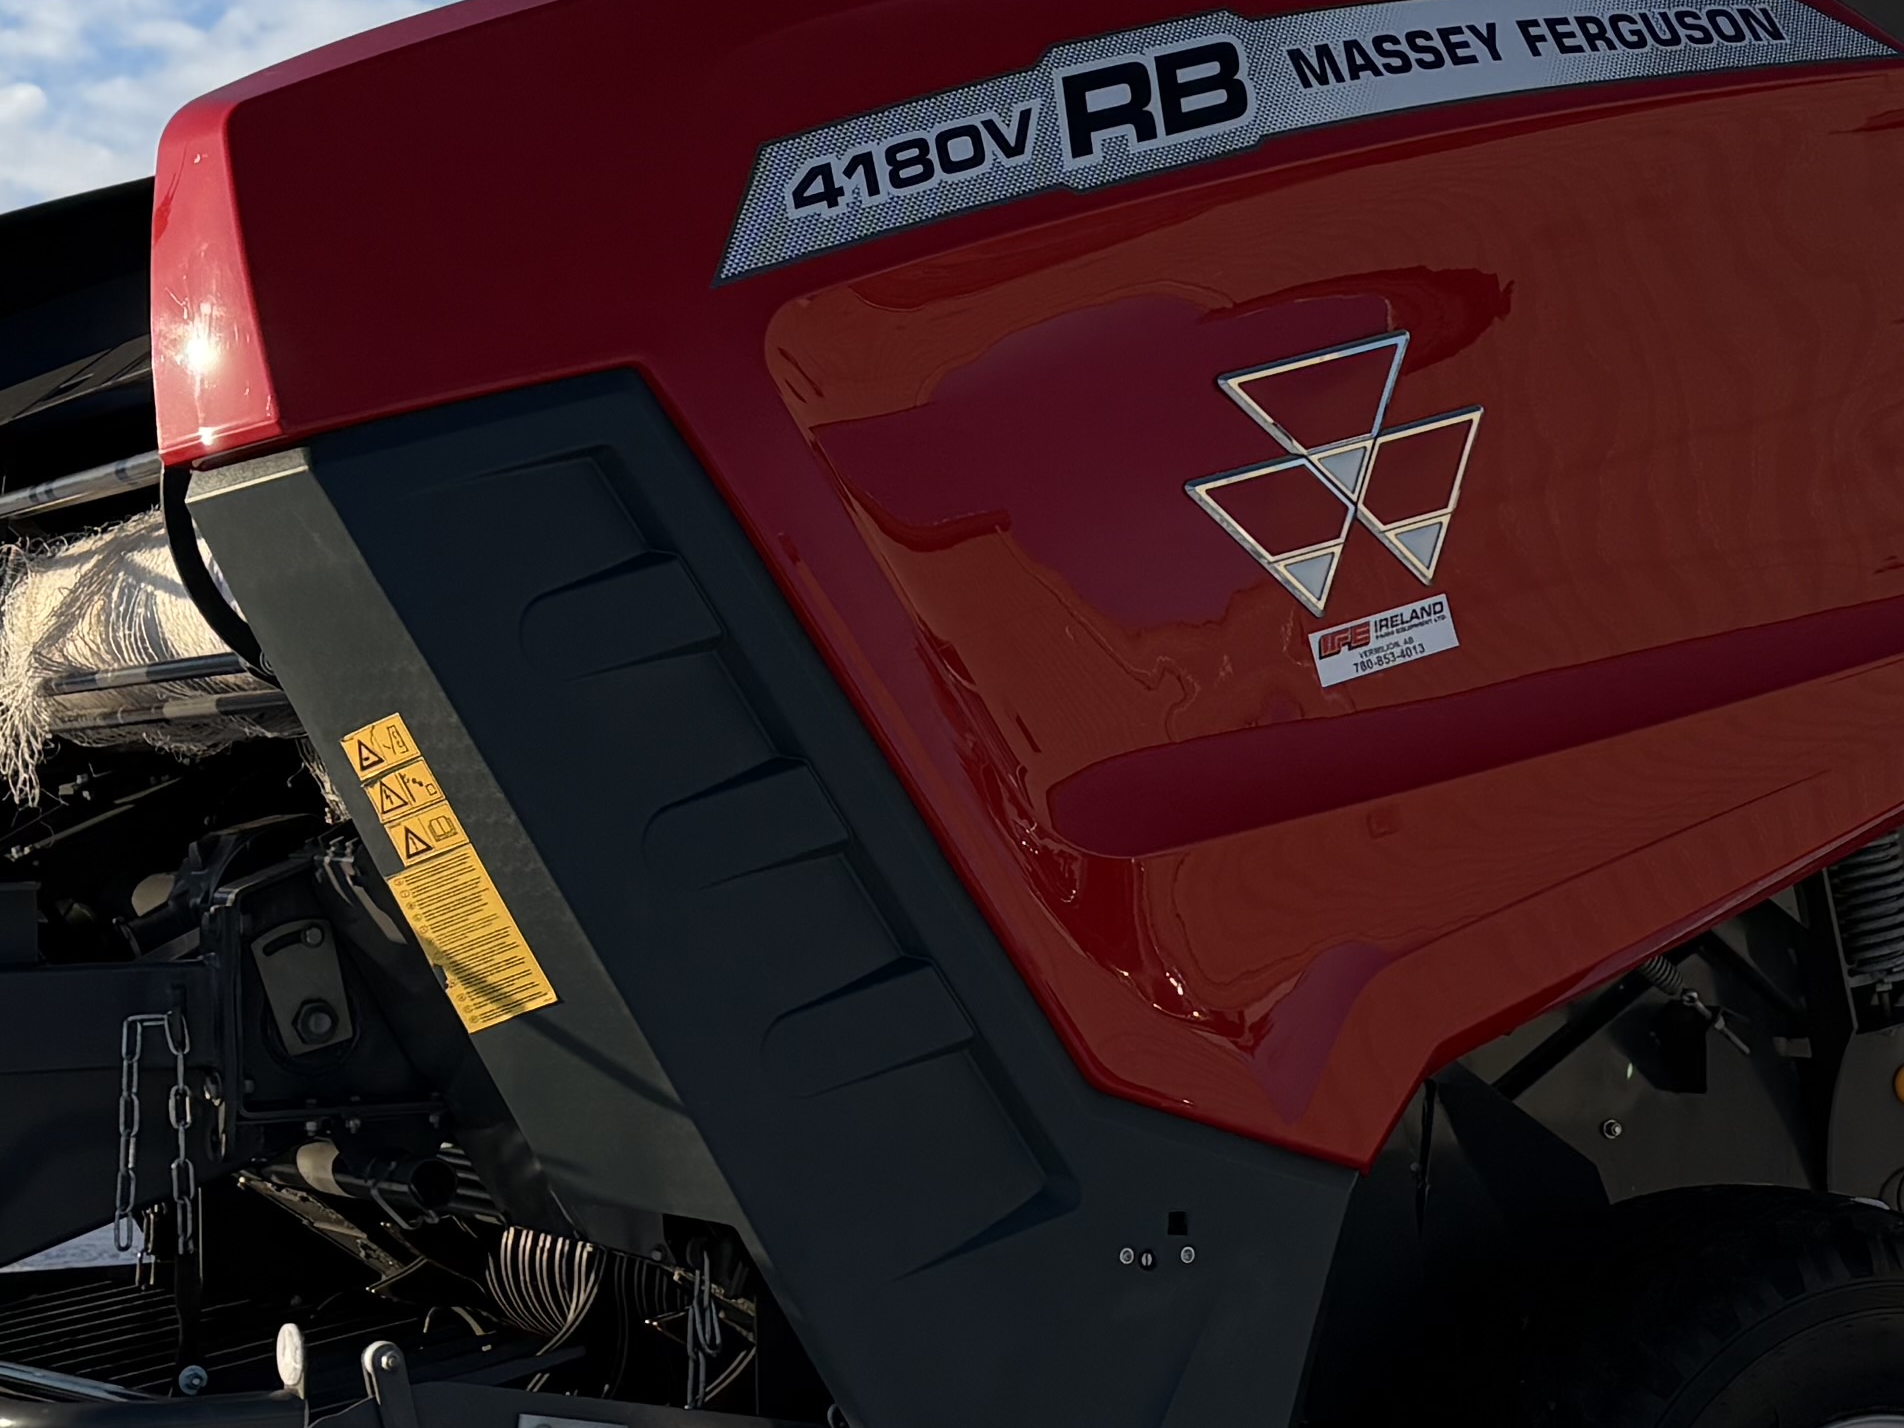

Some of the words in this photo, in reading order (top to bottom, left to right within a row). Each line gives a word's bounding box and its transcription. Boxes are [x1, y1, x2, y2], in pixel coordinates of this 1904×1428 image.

[791, 107, 1034, 211] 4180V
[1061, 41, 1249, 160] RB
[1286, 21, 1503, 90] MASSEY
[1514, 5, 1787, 57] FERGUSON
[1373, 601, 1444, 634] IRELAND
[1403, 636, 1414, 646] AB
[1353, 643, 1426, 673] 780-853-4013
